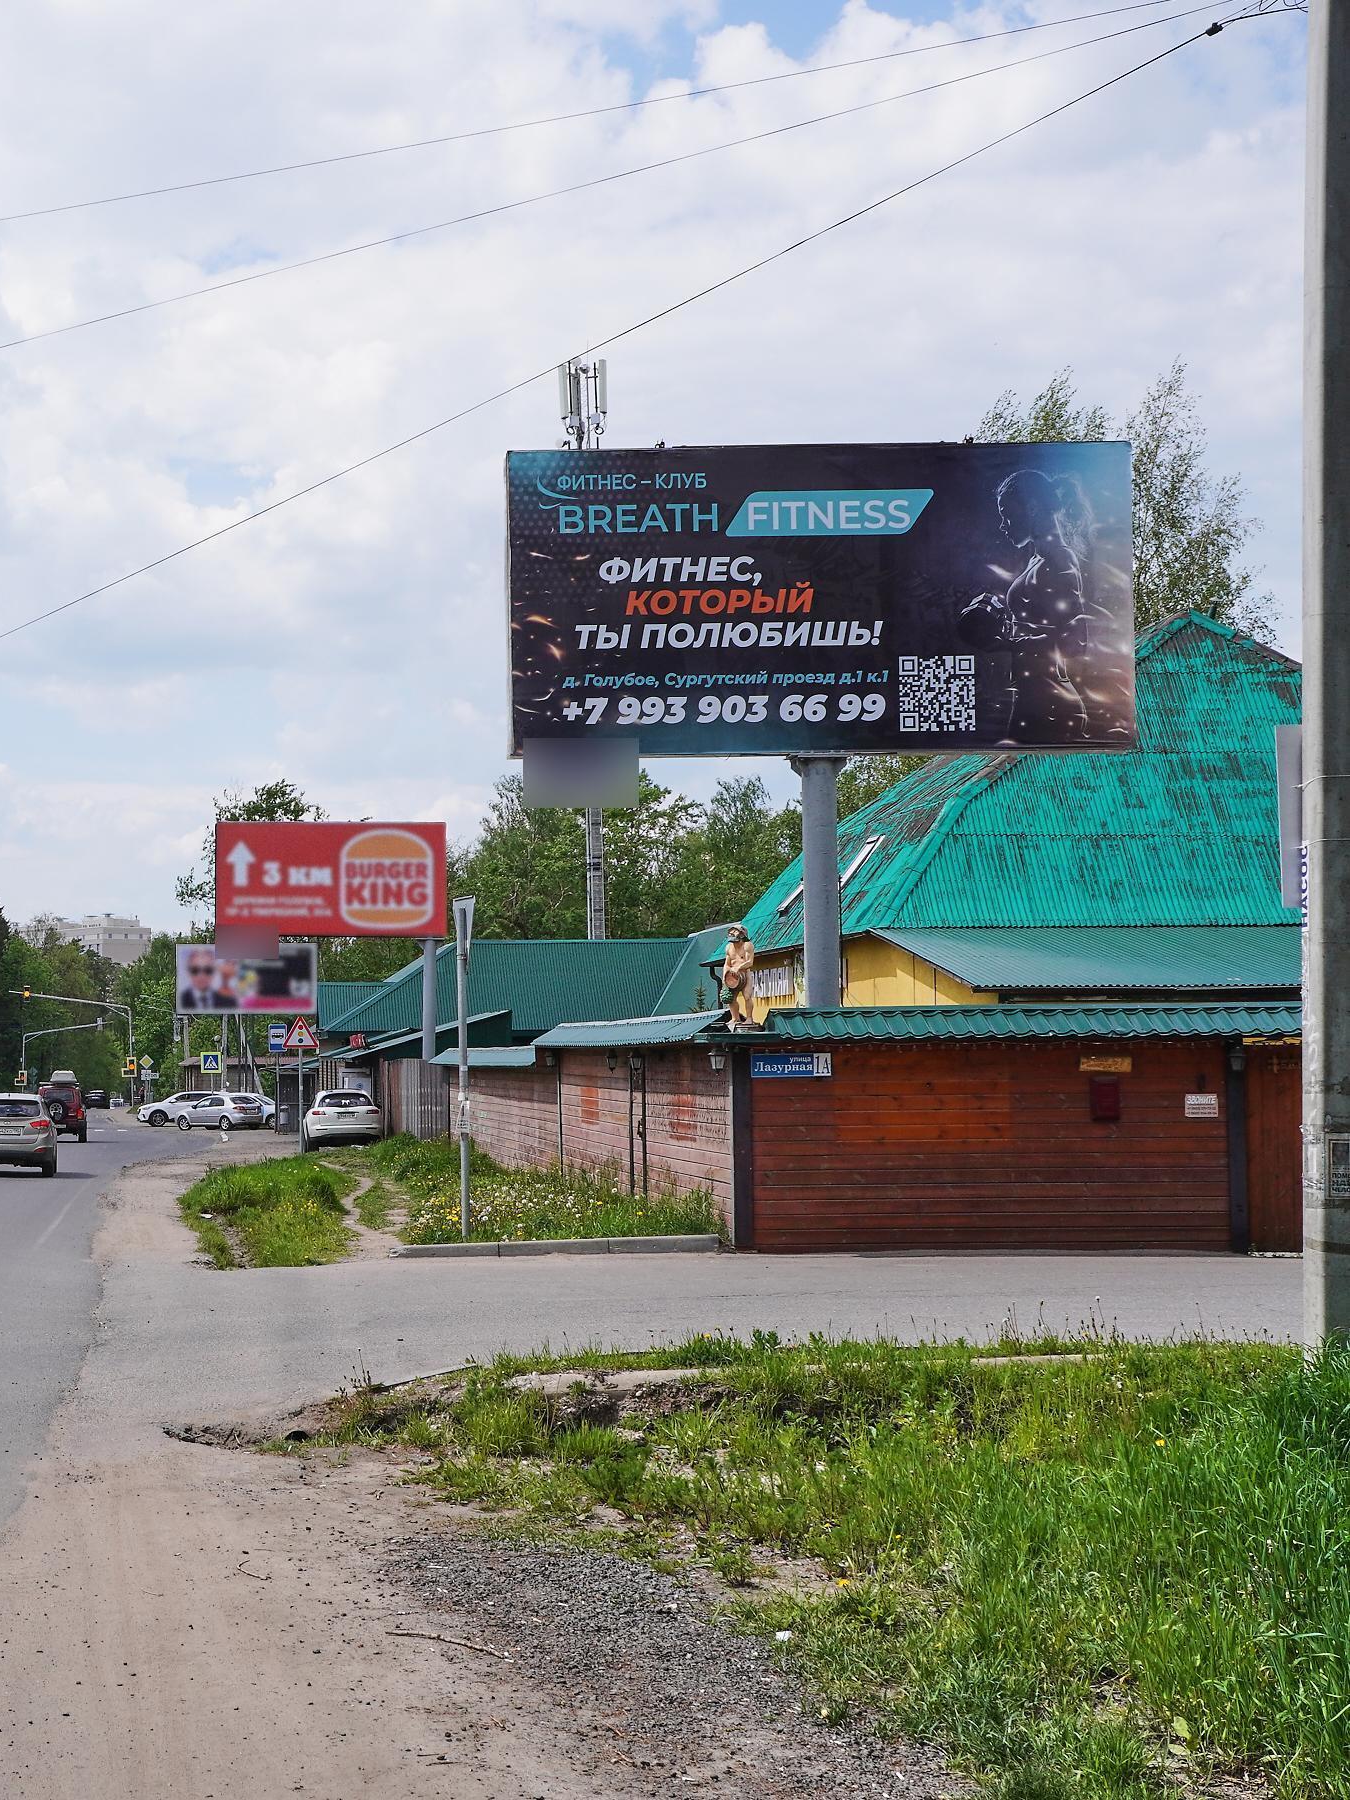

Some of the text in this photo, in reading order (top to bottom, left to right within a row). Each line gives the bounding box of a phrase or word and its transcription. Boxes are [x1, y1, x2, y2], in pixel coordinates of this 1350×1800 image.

[557, 474, 637, 490] ФИТНЕС
[655, 473, 707, 489] КЛУБ
[559, 499, 911, 534] BREATH FITNESS
[599, 555, 763, 586] ФИТНЕС,
[626, 581, 814, 616] КОТОРЫЙ
[575, 620, 884, 649] ТЫ ПОЛЮБИШЬ!
[584, 672, 660, 689] Голубое,
[664, 671, 769, 689] Сургутский
[772, 672, 836, 687] проезд
[839, 670, 863, 685] д.1
[866, 669, 889, 684] к.1
[562, 693, 887, 725] +7 993 903 66 99
[262, 860, 281, 887] 3
[345, 862, 428, 880] BURGER
[345, 881, 428, 906] KING
[754, 1062, 813, 1074] Лазурная
[789, 1056, 812, 1064] улица
[1186, 1095, 1217, 1105] ЗВОНИТЕ
